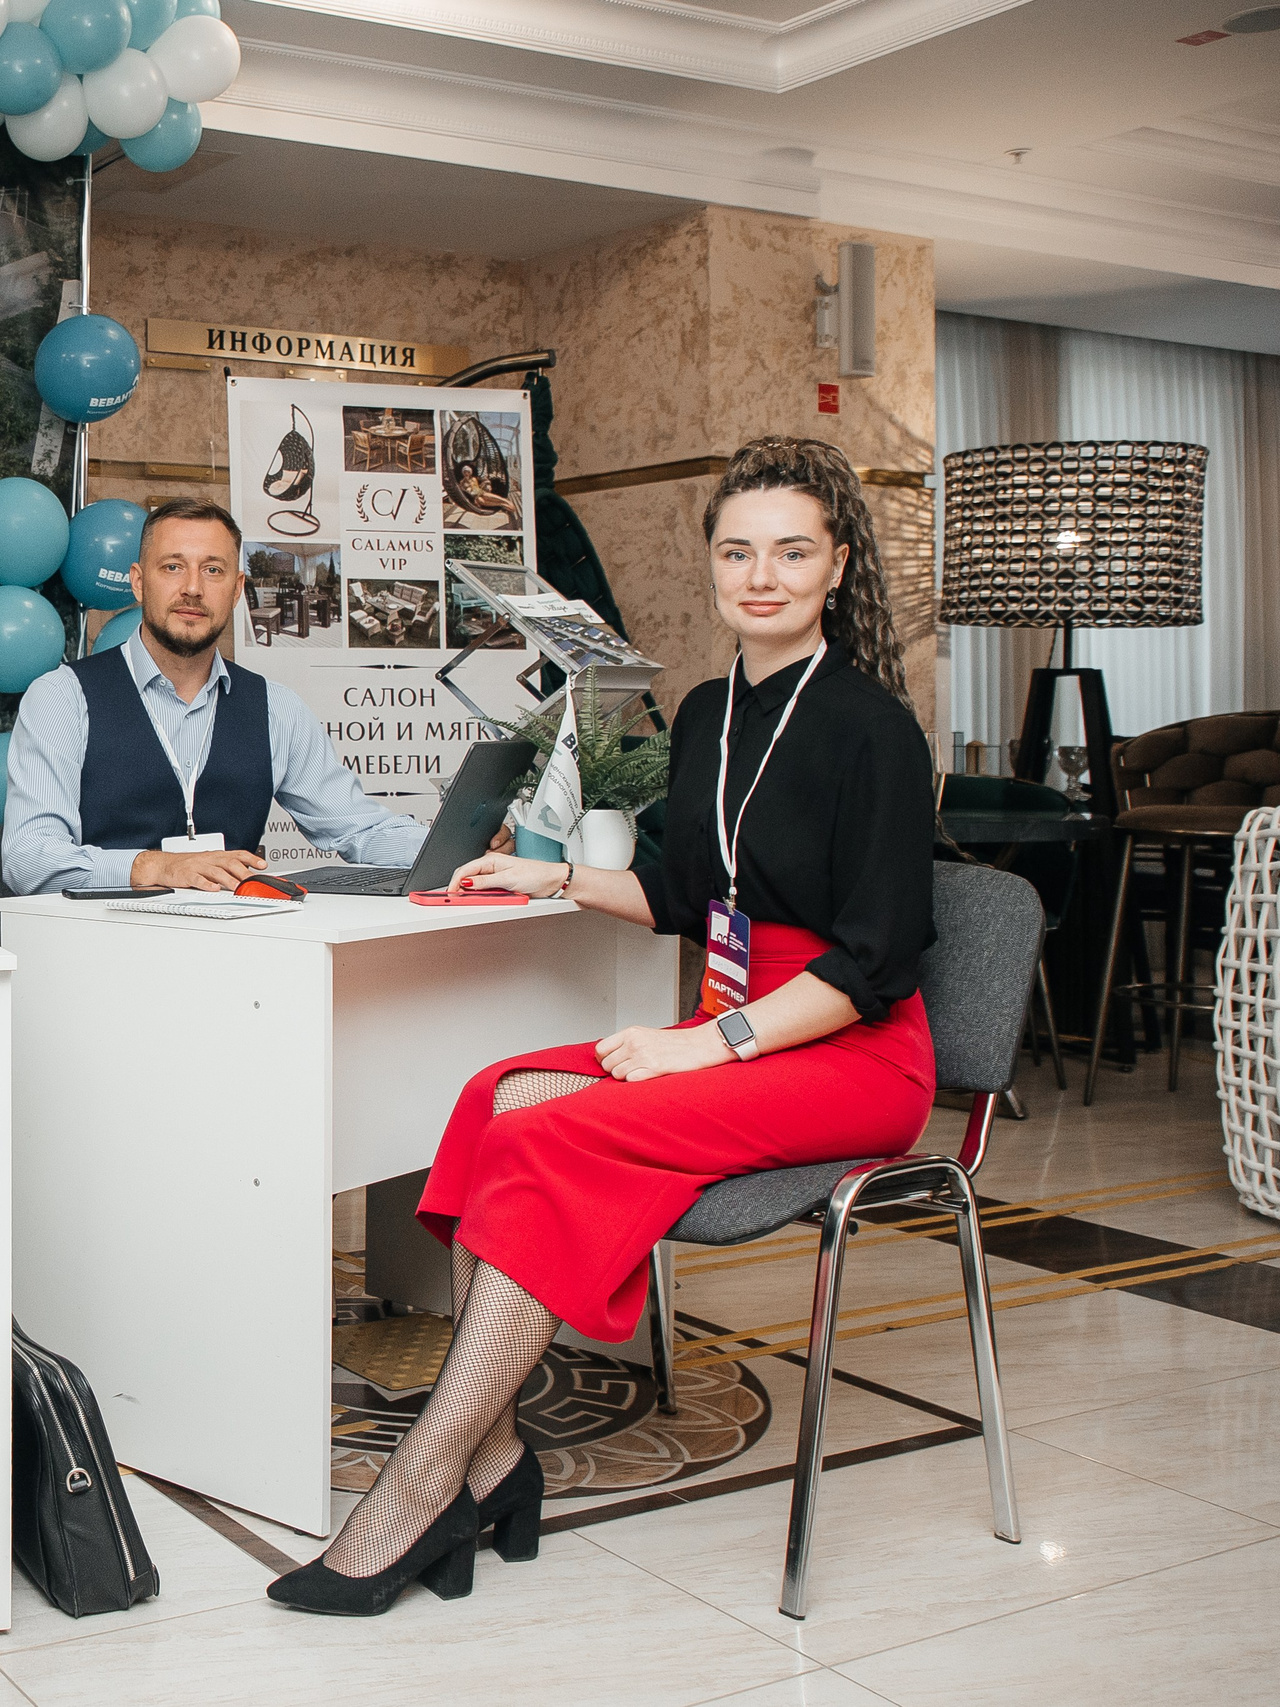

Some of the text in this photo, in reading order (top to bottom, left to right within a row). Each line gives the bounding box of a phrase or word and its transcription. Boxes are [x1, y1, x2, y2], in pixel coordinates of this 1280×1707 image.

[206, 327, 416, 368] ИНФОРМАЦИЯ
[351, 537, 435, 553] CALAMUS
[378, 557, 407, 571] VIP
[343, 687, 436, 707] САЛОН
[320, 716, 385, 741] НОЙ
[397, 722, 413, 741] И
[342, 755, 441, 774] МЕБЕЛИ
[708, 978, 745, 1004] ПАРТНЕР
